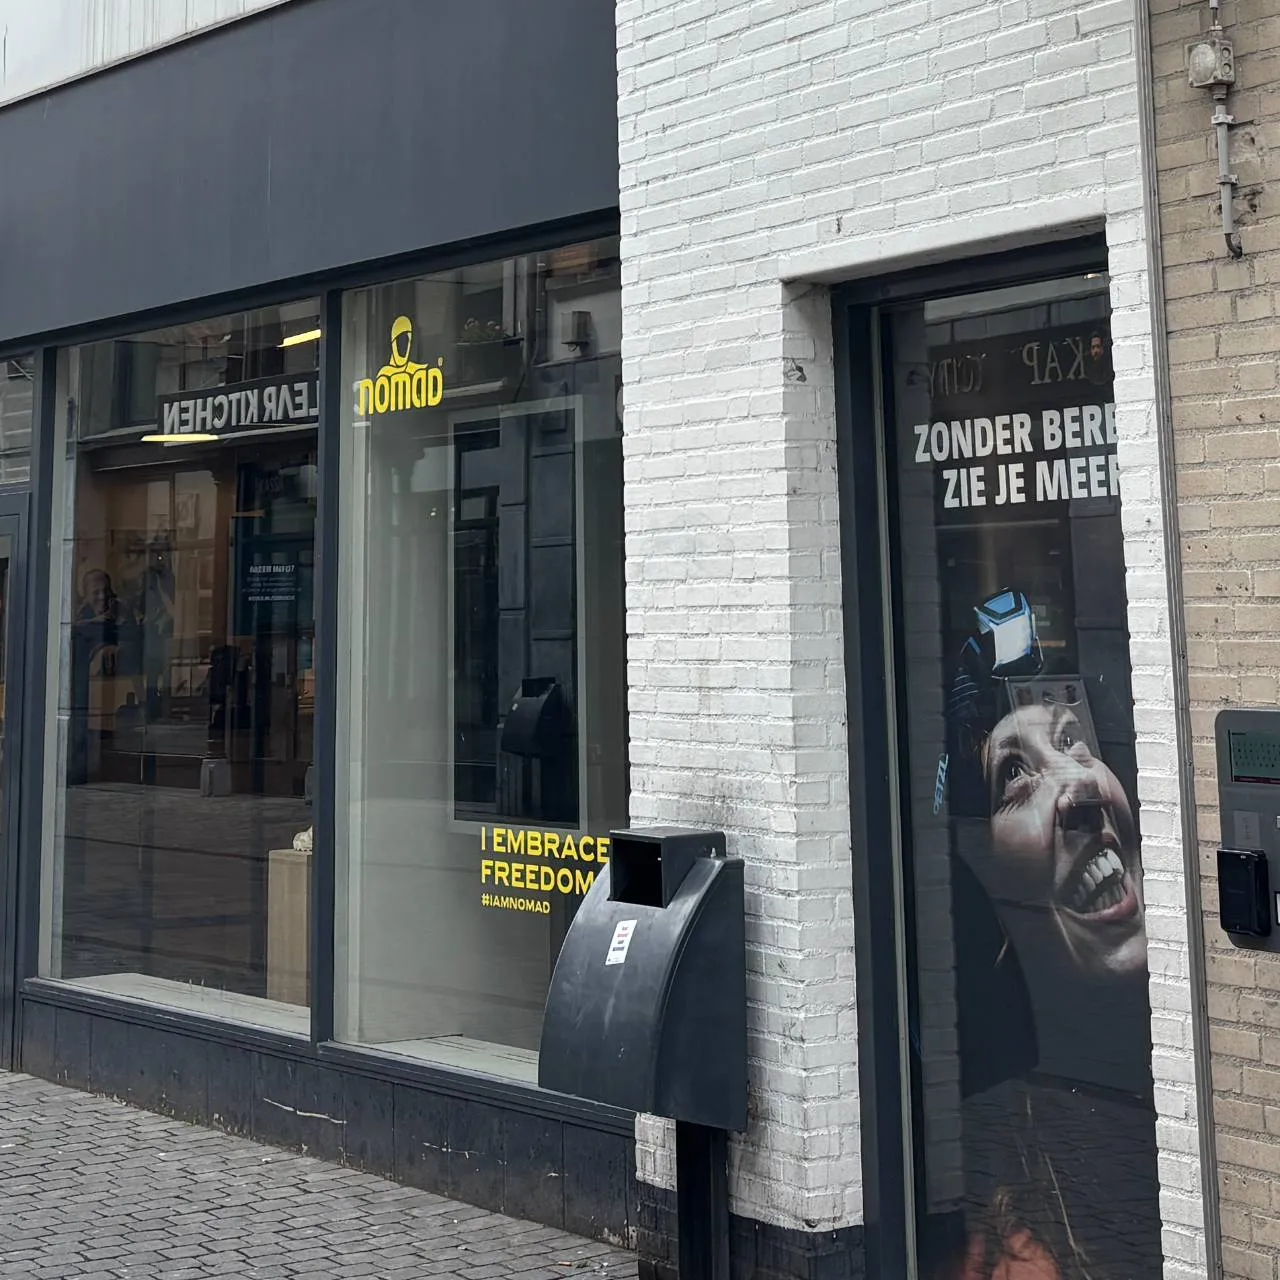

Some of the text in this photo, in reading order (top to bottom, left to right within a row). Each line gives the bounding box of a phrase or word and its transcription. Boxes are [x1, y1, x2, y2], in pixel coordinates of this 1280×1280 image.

[914, 412, 1034, 463] ZONDER
[943, 466, 987, 509] ZIE
[995, 463, 1026, 505] JE
[481, 826, 611, 864] I EMBRACE
[481, 859, 595, 895] FREEDOM
[481, 892, 551, 914] #IAMNOMAD
